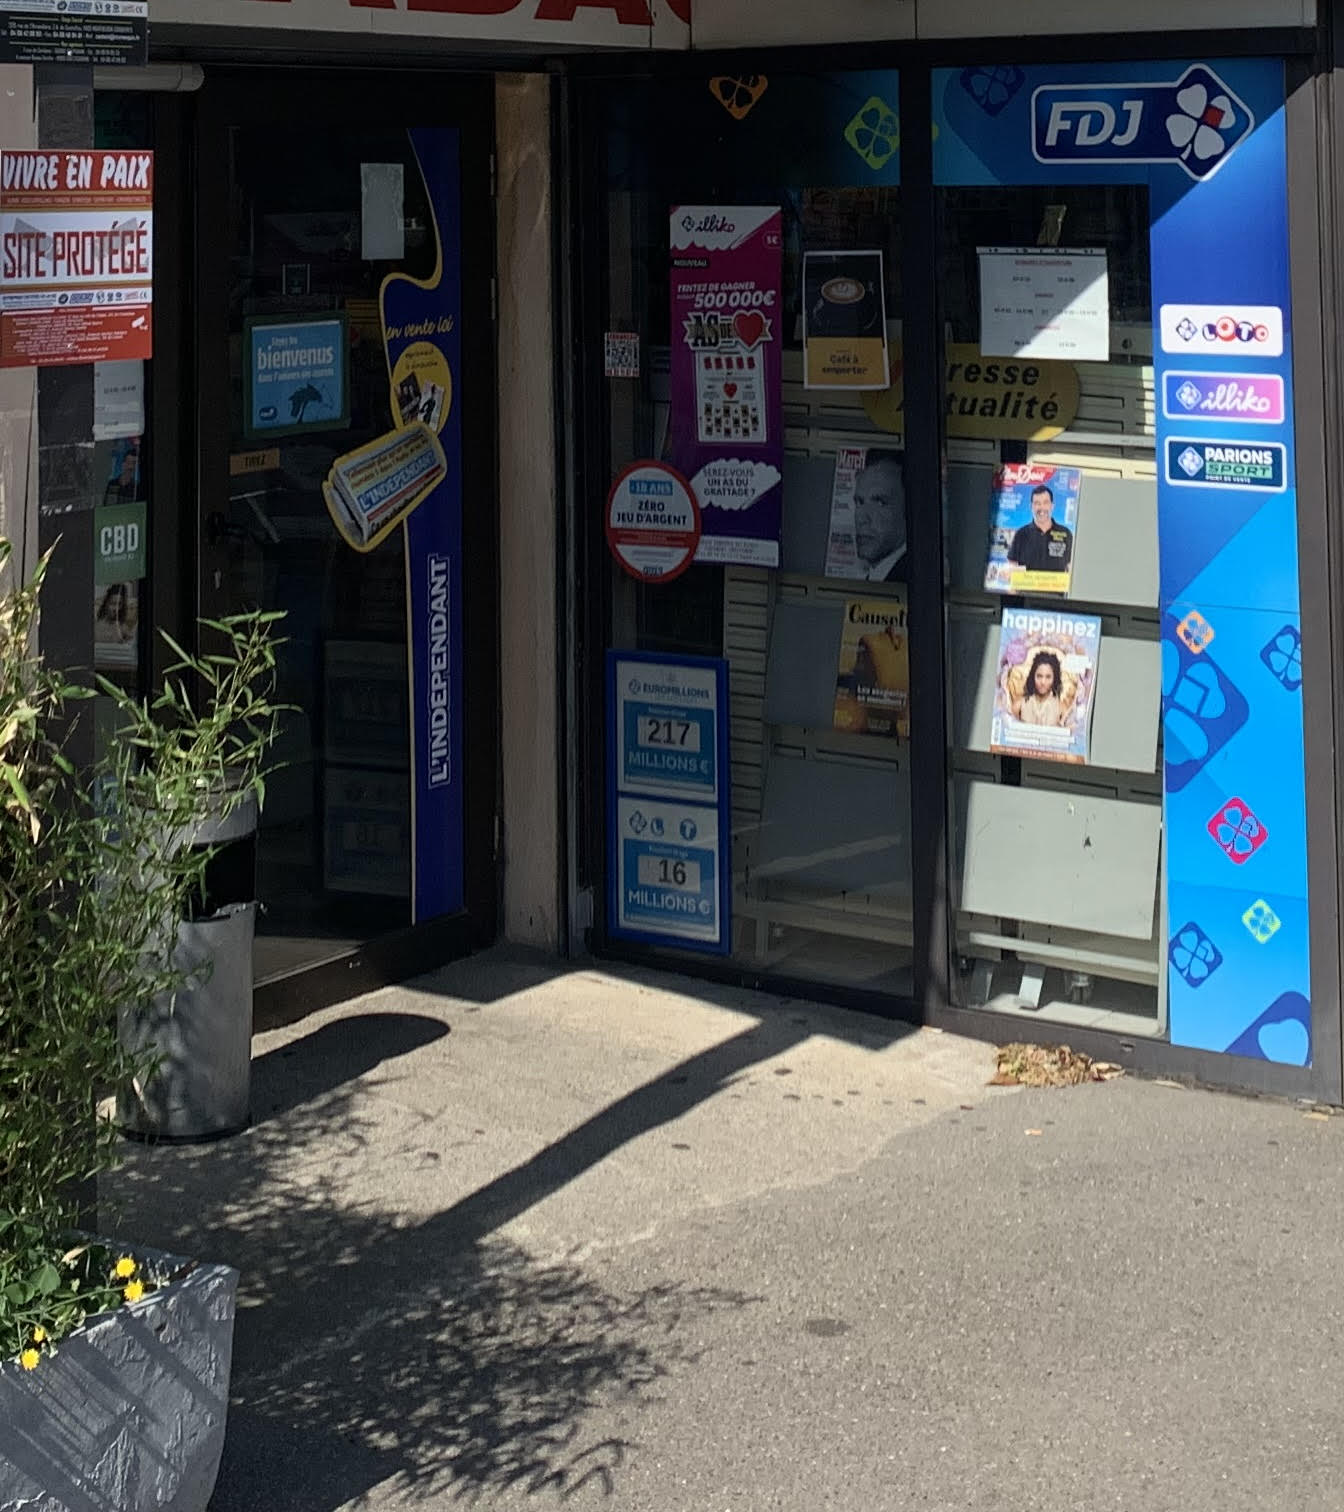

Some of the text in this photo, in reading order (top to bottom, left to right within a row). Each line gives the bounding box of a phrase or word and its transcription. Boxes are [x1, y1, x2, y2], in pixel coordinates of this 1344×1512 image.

[1045, 100, 1144, 146] FDJ
[3, 155, 150, 190] VIVRE EN PAIX
[694, 214, 736, 232] illiko
[3, 220, 148, 279] SITE PROTÉGÉ
[720, 281, 756, 291] GAGNER
[694, 292, 727, 308] 500
[404, 318, 436, 338] vente
[691, 313, 720, 348] AS
[1202, 316, 1270, 342] LOTO
[257, 345, 334, 370] bienvenus
[946, 362, 1041, 386] resse
[896, 392, 1059, 420] tualité
[1200, 382, 1272, 413] illiko
[1205, 446, 1274, 465] PARIONS
[703, 468, 754, 478] SEREZ-VOUS
[1208, 463, 1272, 478] SPORT
[704, 487, 749, 498] GRATTAGE
[707, 478, 749, 488] UN AS DU
[638, 500, 665, 512] ZÉRO
[616, 513, 687, 525] JEU D'ARGENT
[101, 523, 139, 556] CBD
[1003, 608, 1096, 637] happinez
[429, 552, 452, 787] L'INDEPENDANT
[643, 682, 710, 699] EUROMILLIONS
[648, 719, 690, 746] 217
[628, 751, 709, 775] MILLIONS €
[659, 859, 686, 885] 16
[628, 889, 711, 915] MILLIONS €
